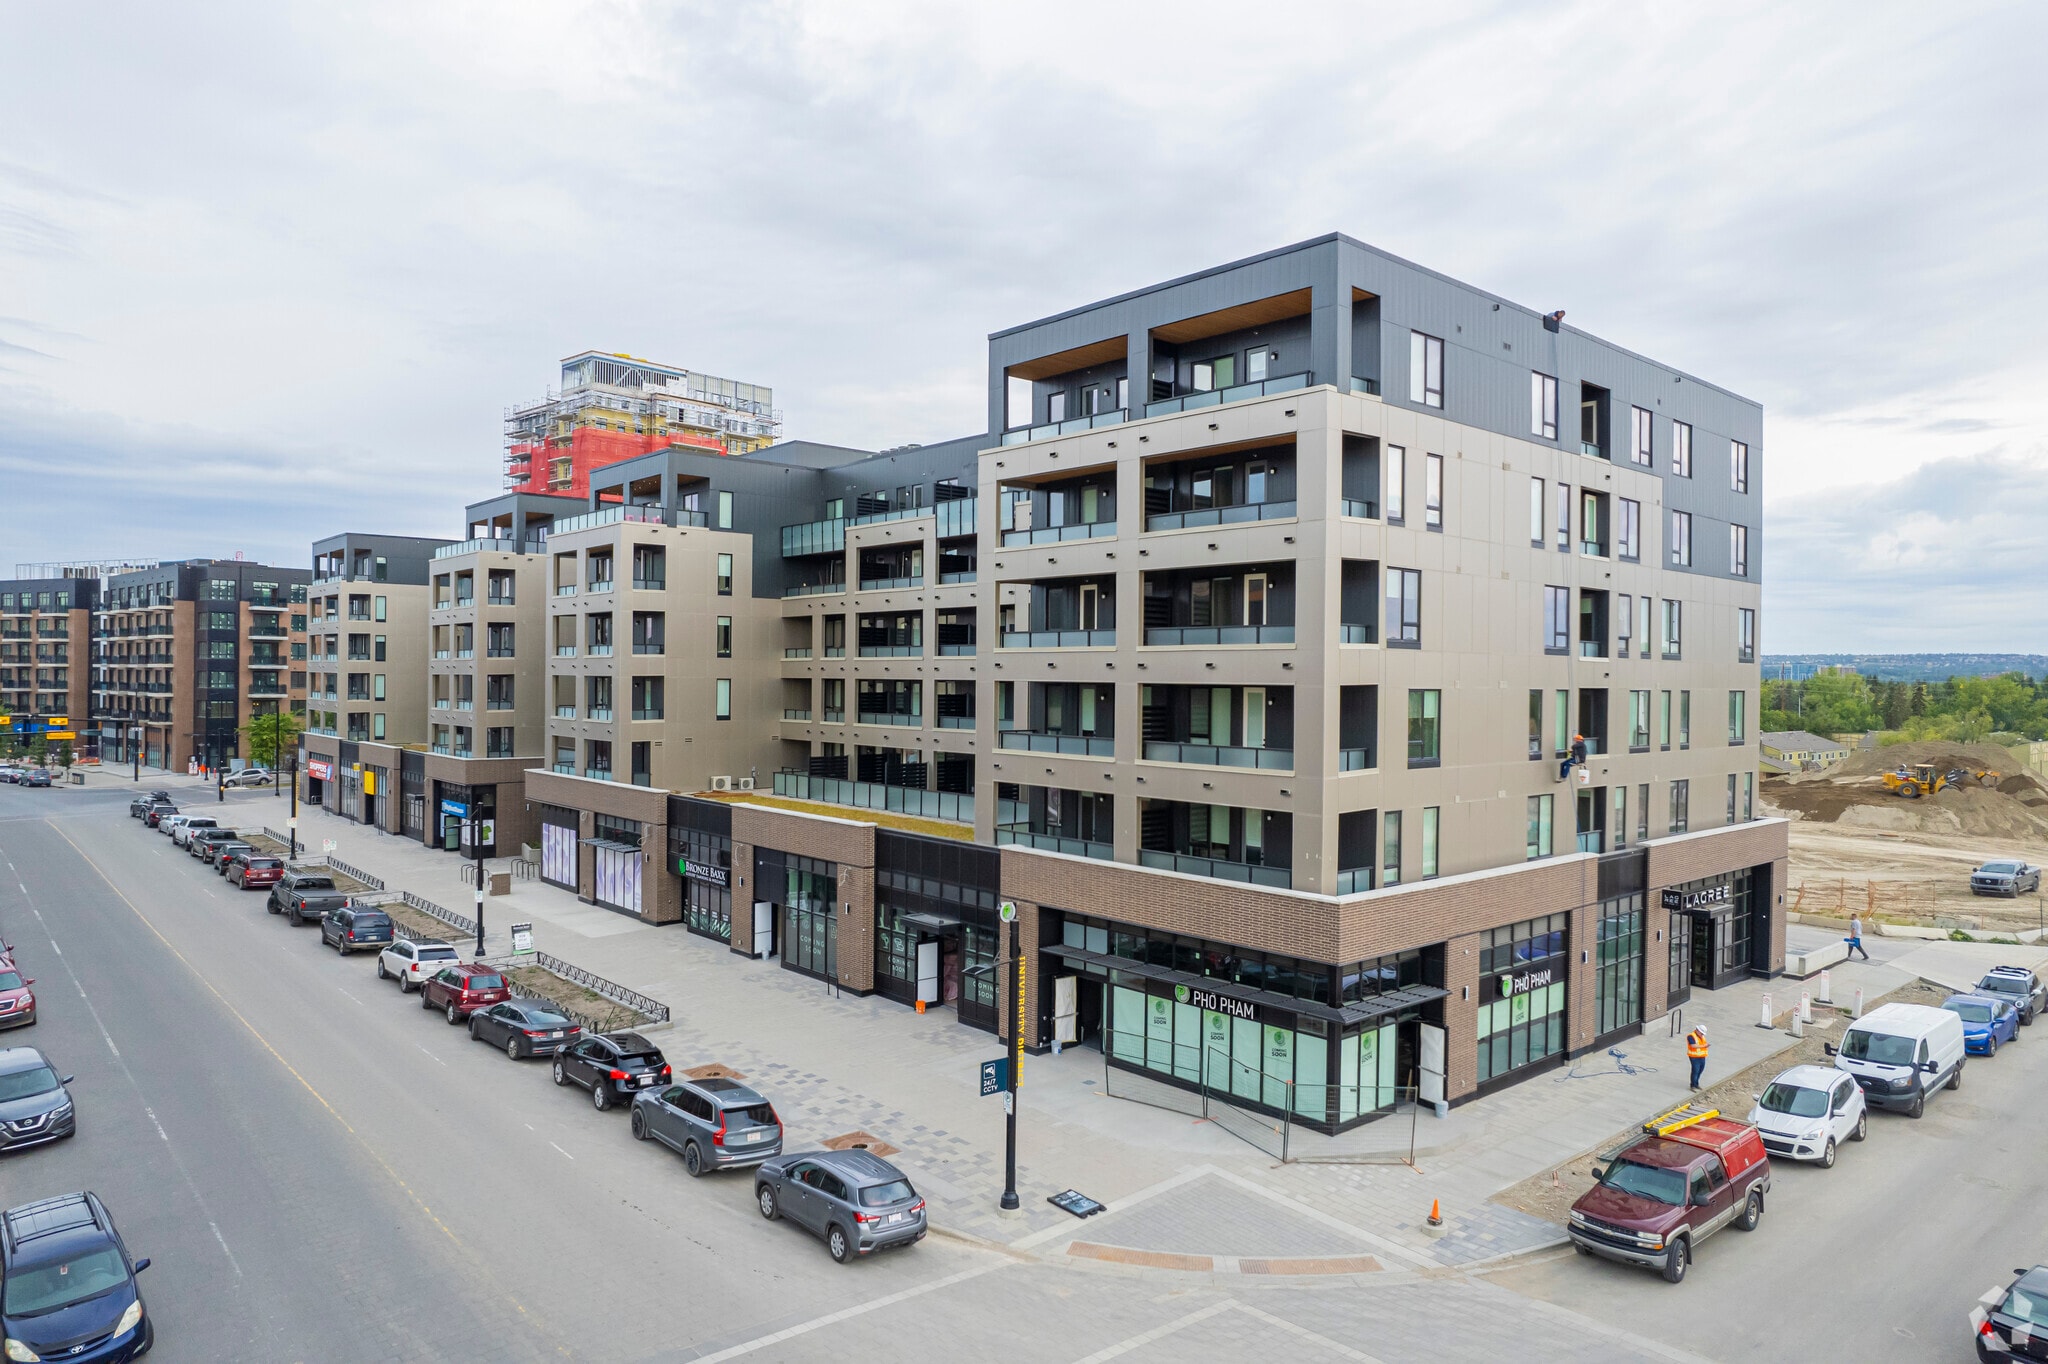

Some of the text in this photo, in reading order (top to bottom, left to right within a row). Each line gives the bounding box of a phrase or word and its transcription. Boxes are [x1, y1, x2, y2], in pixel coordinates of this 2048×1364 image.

[685, 861, 726, 881] BRONZE BAXX
[1686, 885, 1730, 909] LAGREE
[973, 980, 1000, 993] COMING
[1530, 969, 1551, 989] PHAM
[978, 990, 994, 1000] SOON
[1220, 997, 1254, 1020] PHAM
[1017, 955, 1026, 1087] UNIVERSITY DISTRICT
[983, 1078, 996, 1087] 24/7
[983, 1084, 999, 1093] CCTV
